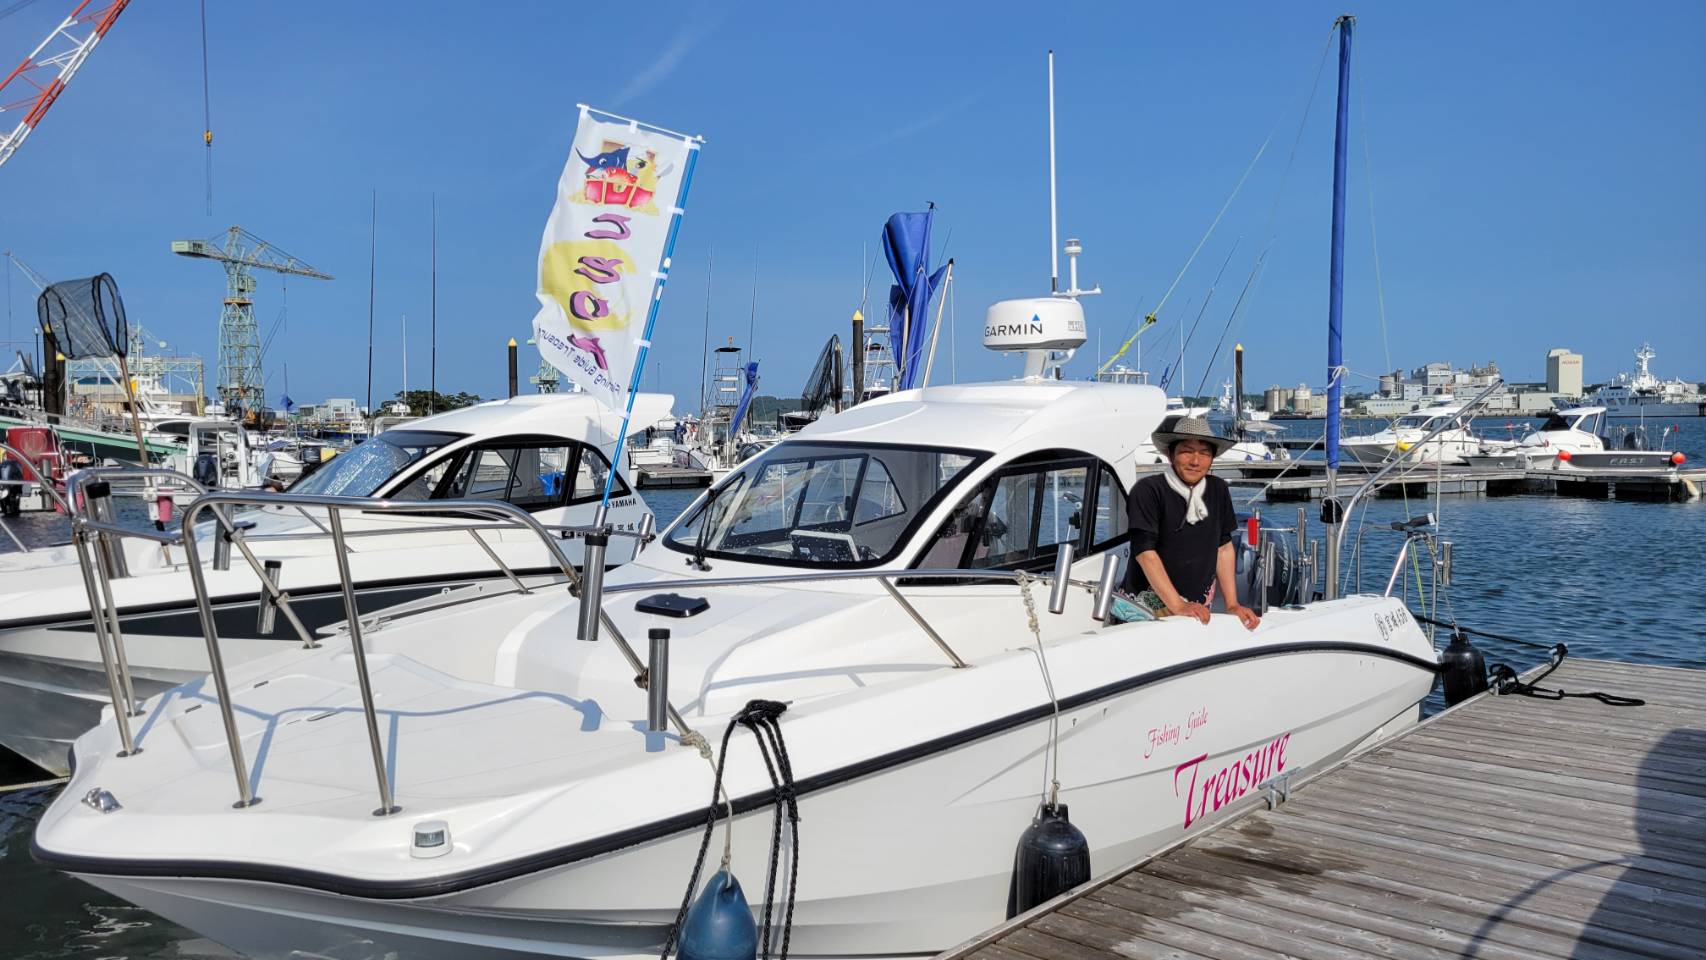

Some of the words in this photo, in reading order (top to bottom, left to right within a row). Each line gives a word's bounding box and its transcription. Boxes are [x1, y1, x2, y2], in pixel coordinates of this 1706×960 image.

[984, 323, 1043, 337] GARMIN
[611, 498, 637, 508] YAMAHA
[1144, 724, 1181, 758] Fishing
[1185, 704, 1209, 740] Guide
[1173, 733, 1292, 829] Treasure
